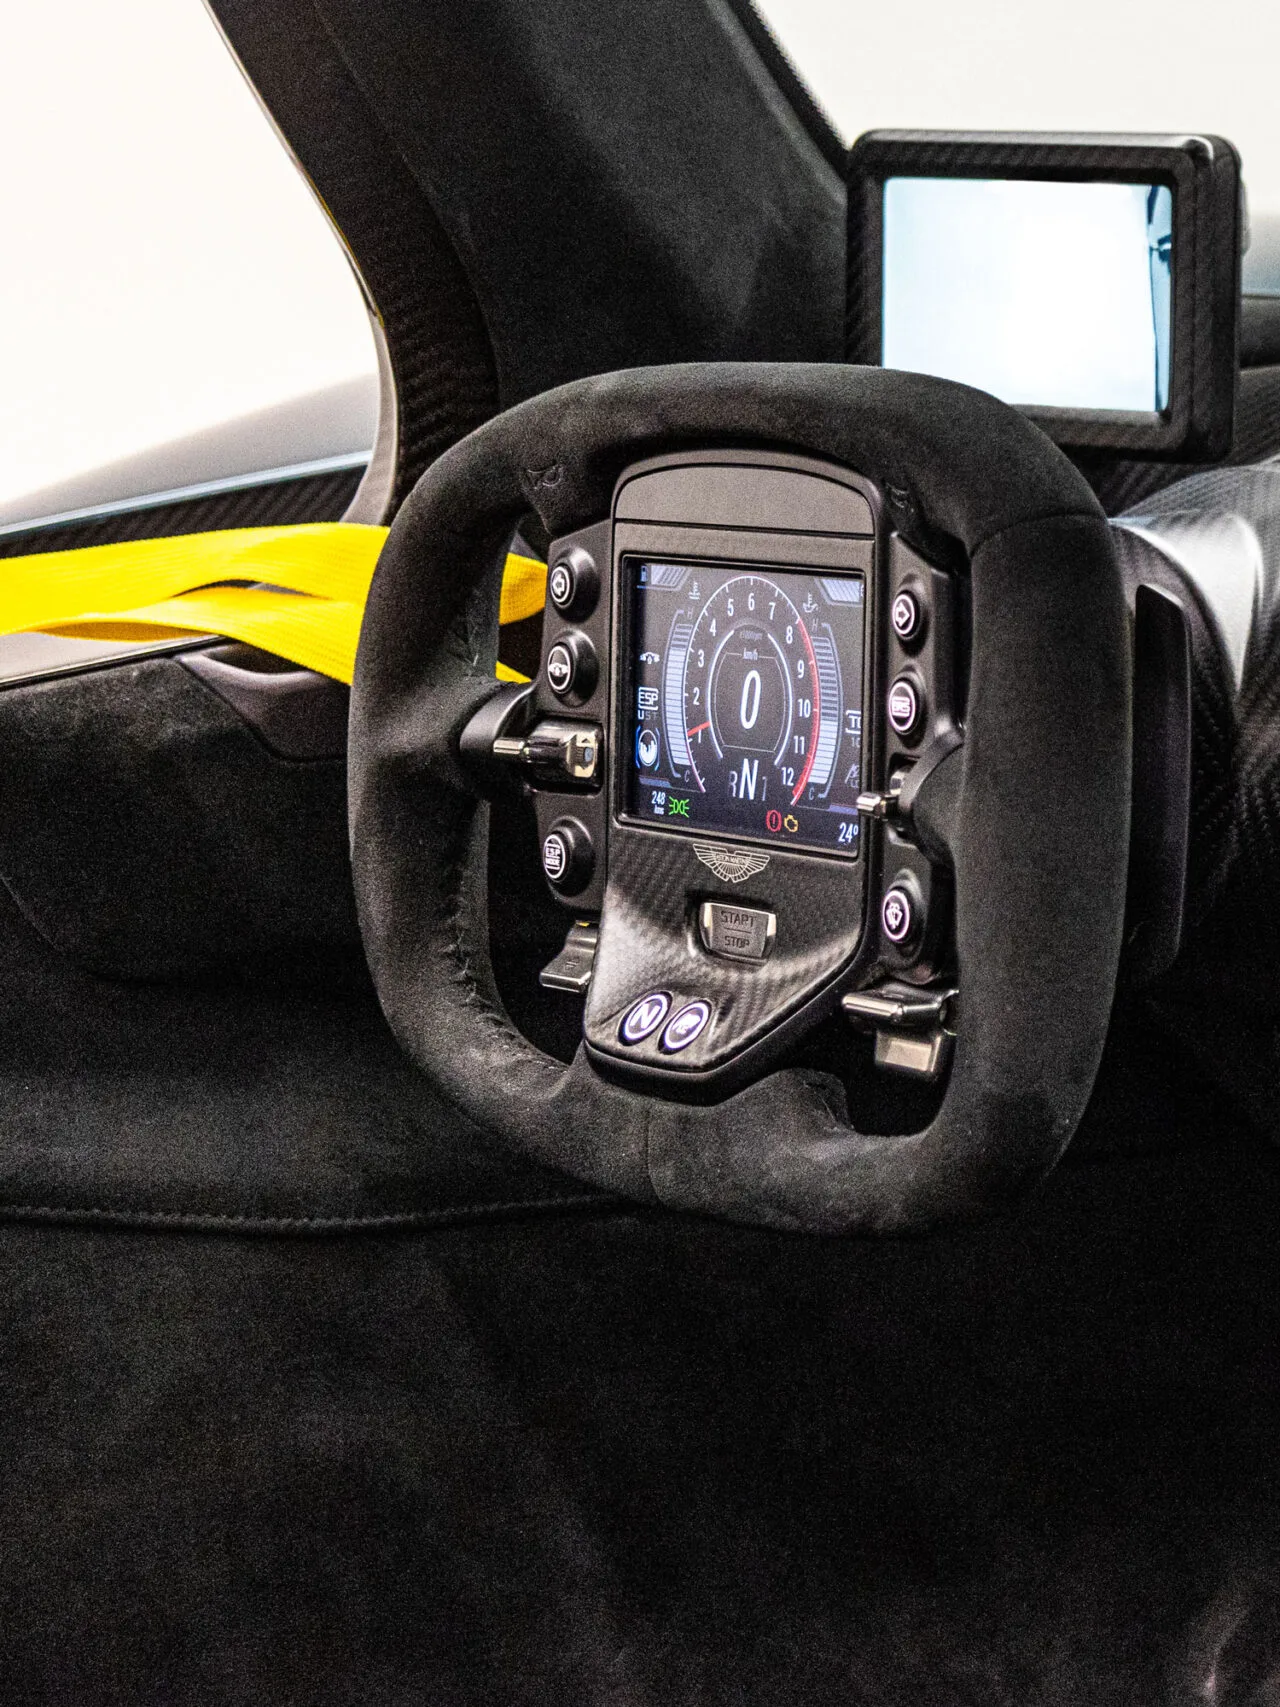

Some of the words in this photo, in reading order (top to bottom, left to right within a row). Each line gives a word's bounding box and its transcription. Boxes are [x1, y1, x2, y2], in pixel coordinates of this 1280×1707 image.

[727, 599, 735, 617] 5
[748, 593, 756, 611] 6
[768, 602, 777, 620] 7
[709, 618, 717, 637] 4
[785, 625, 794, 644] 8
[697, 649, 705, 668] 3
[797, 659, 805, 679] 9
[638, 691, 659, 706] ESP
[693, 687, 701, 706] 2
[740, 669, 761, 729] 0
[798, 698, 812, 718] 10
[794, 735, 805, 755] 11
[738, 758, 759, 801] N
[781, 766, 795, 787] 12
[651, 791, 666, 806] 248
[720, 910, 757, 927] START
[724, 936, 750, 949] STOP
[629, 1002, 661, 1030] N
